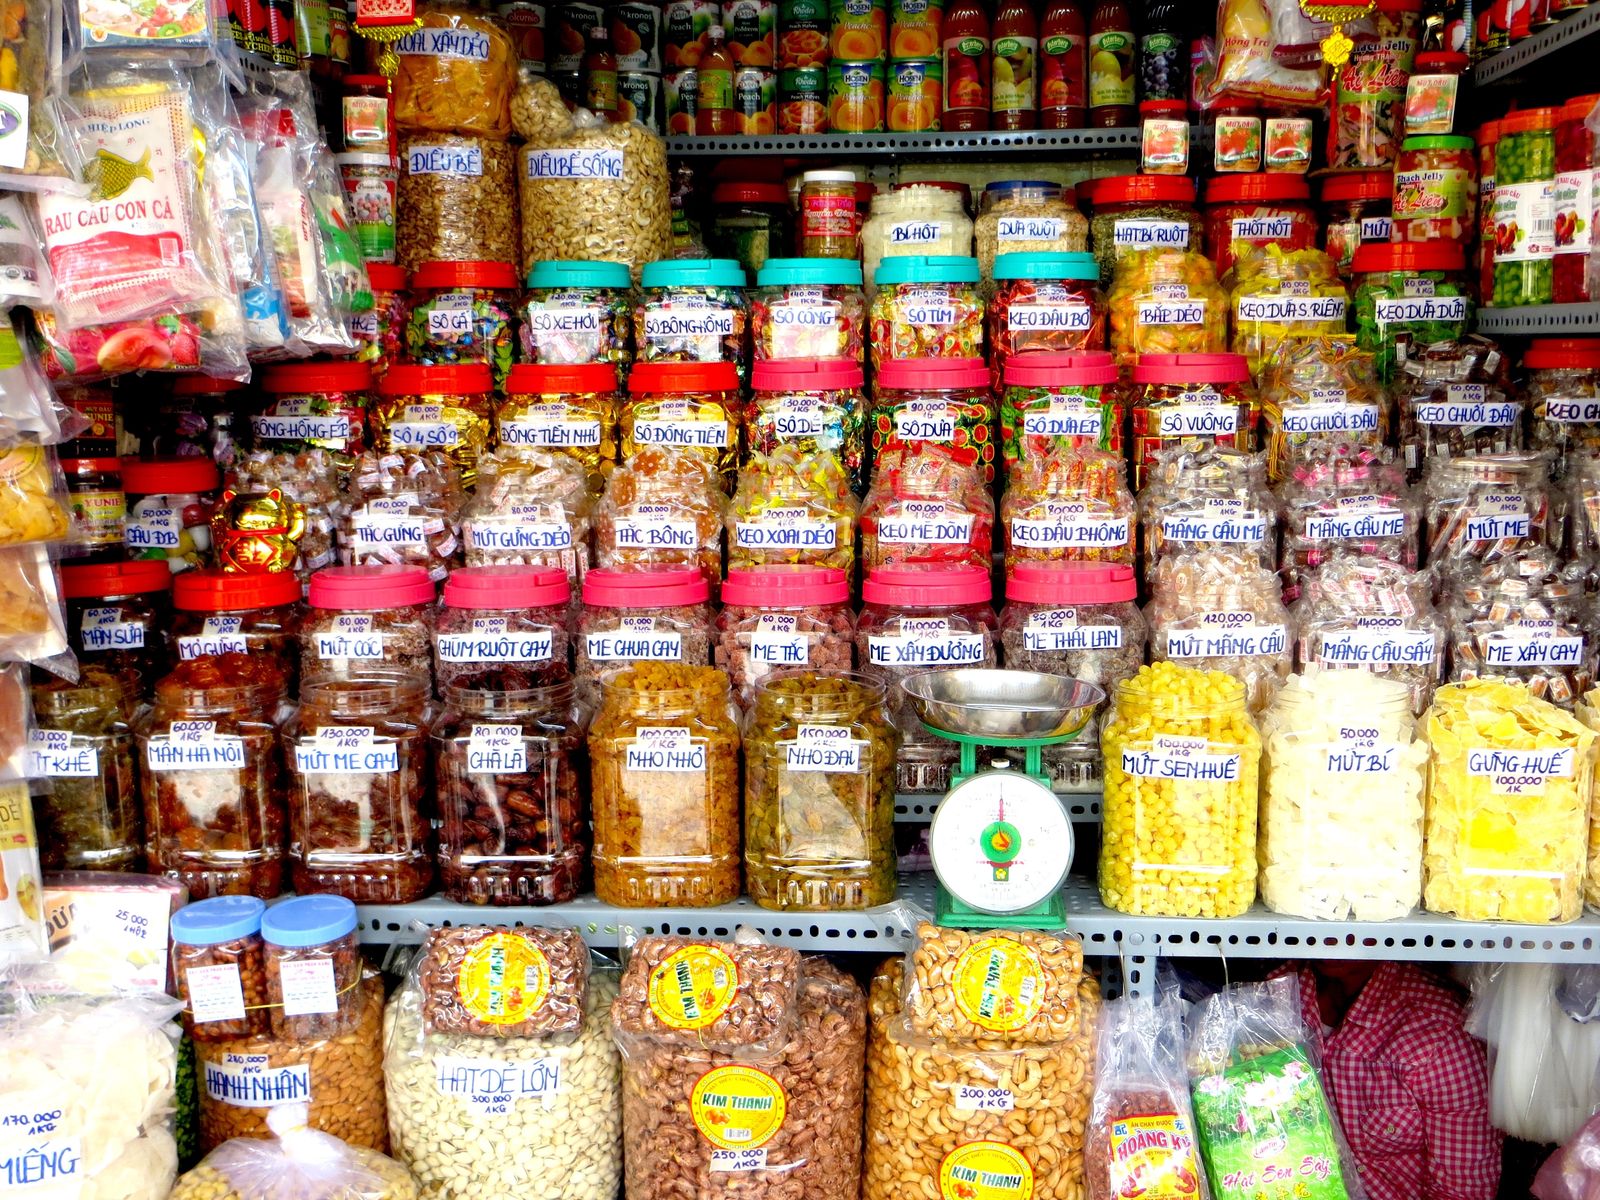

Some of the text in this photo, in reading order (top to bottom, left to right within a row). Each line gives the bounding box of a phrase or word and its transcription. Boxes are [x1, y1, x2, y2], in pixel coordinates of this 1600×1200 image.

[844, 75, 869, 84] HOSEN
[45, 212, 72, 237] RAU
[115, 201, 147, 221] CON
[911, 403, 945, 411] 90.000
[1161, 412, 1183, 431] SÔ
[415, 431, 425, 445] 4
[448, 430, 457, 444] 9
[1382, 517, 1403, 535] ME
[1507, 518, 1529, 537] ME
[647, 524, 694, 545] BÔNG
[624, 617, 652, 625] 60.000
[763, 616, 795, 625] 60.000
[1203, 612, 1252, 624] 120.000
[589, 639, 612, 657] ME
[1024, 632, 1048, 650] ME
[1090, 630, 1118, 647] LAN
[754, 644, 777, 660] ME
[870, 644, 891, 661] ME
[1488, 645, 1513, 662] ME
[173, 721, 213, 732] 60.000
[320, 728, 370, 738] 130.000
[334, 753, 361, 769] ME
[364, 752, 396, 770] CAY
[788, 749, 823, 765] NHO
[1161, 762, 1196, 778] SEN
[1495, 775, 1542, 785] 100.000
[702, 1093, 773, 1109] KIM THANH
[960, 1088, 1011, 1098] 300.000
[713, 1149, 763, 1160] 250.000
[951, 1166, 1022, 1188] KIM THANH
